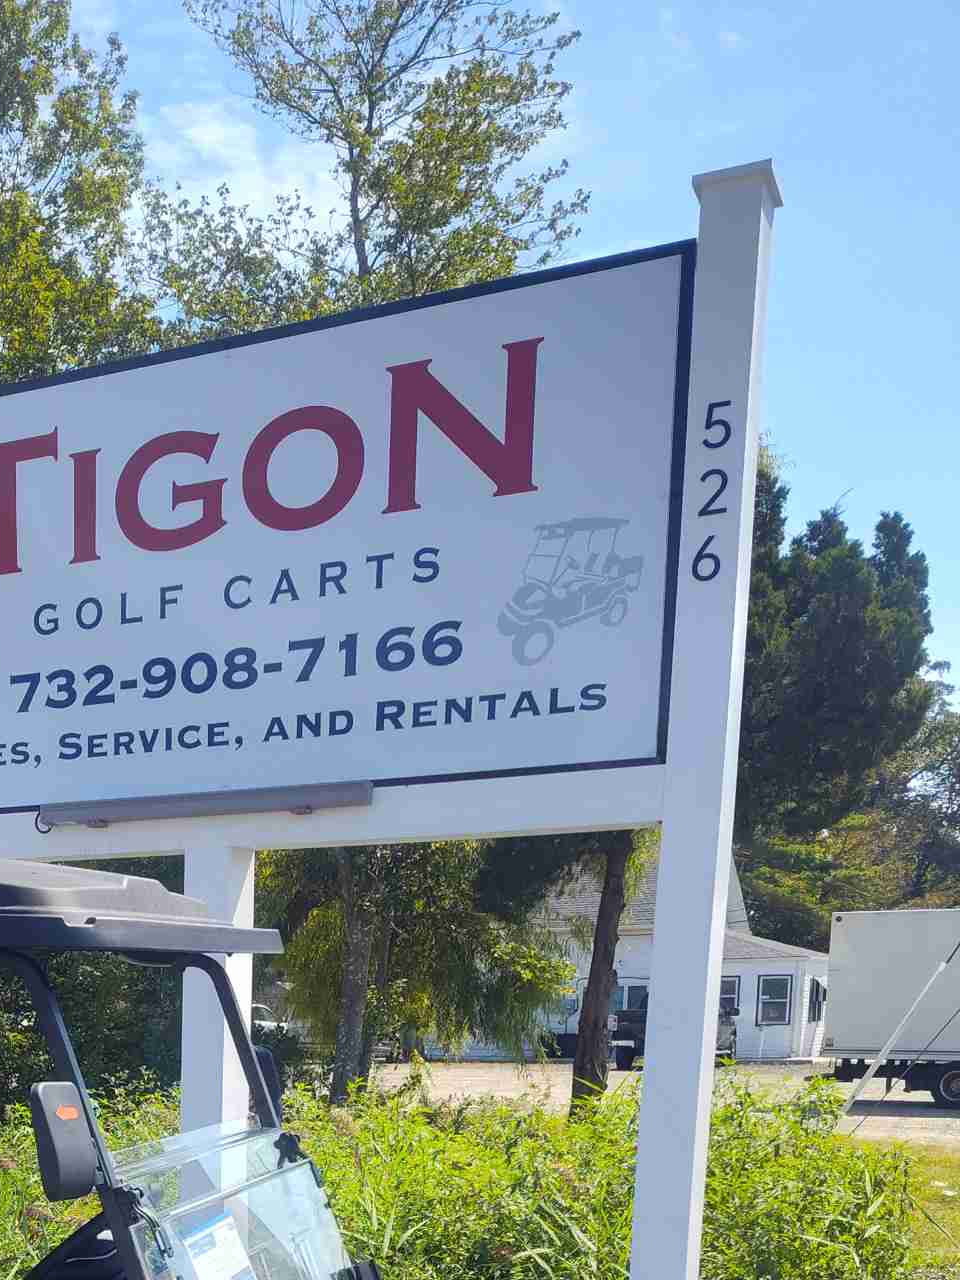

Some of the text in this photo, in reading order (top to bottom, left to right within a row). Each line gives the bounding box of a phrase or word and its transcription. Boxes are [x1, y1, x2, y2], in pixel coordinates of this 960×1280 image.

[691, 399, 733, 583] 526
[32, 546, 442, 637] GOLF CARTS
[8, 619, 465, 715] 732-908-7166
[57, 720, 245, 762] SERVICE,
[260, 708, 355, 744] AND
[374, 682, 608, 733] RENTALS
